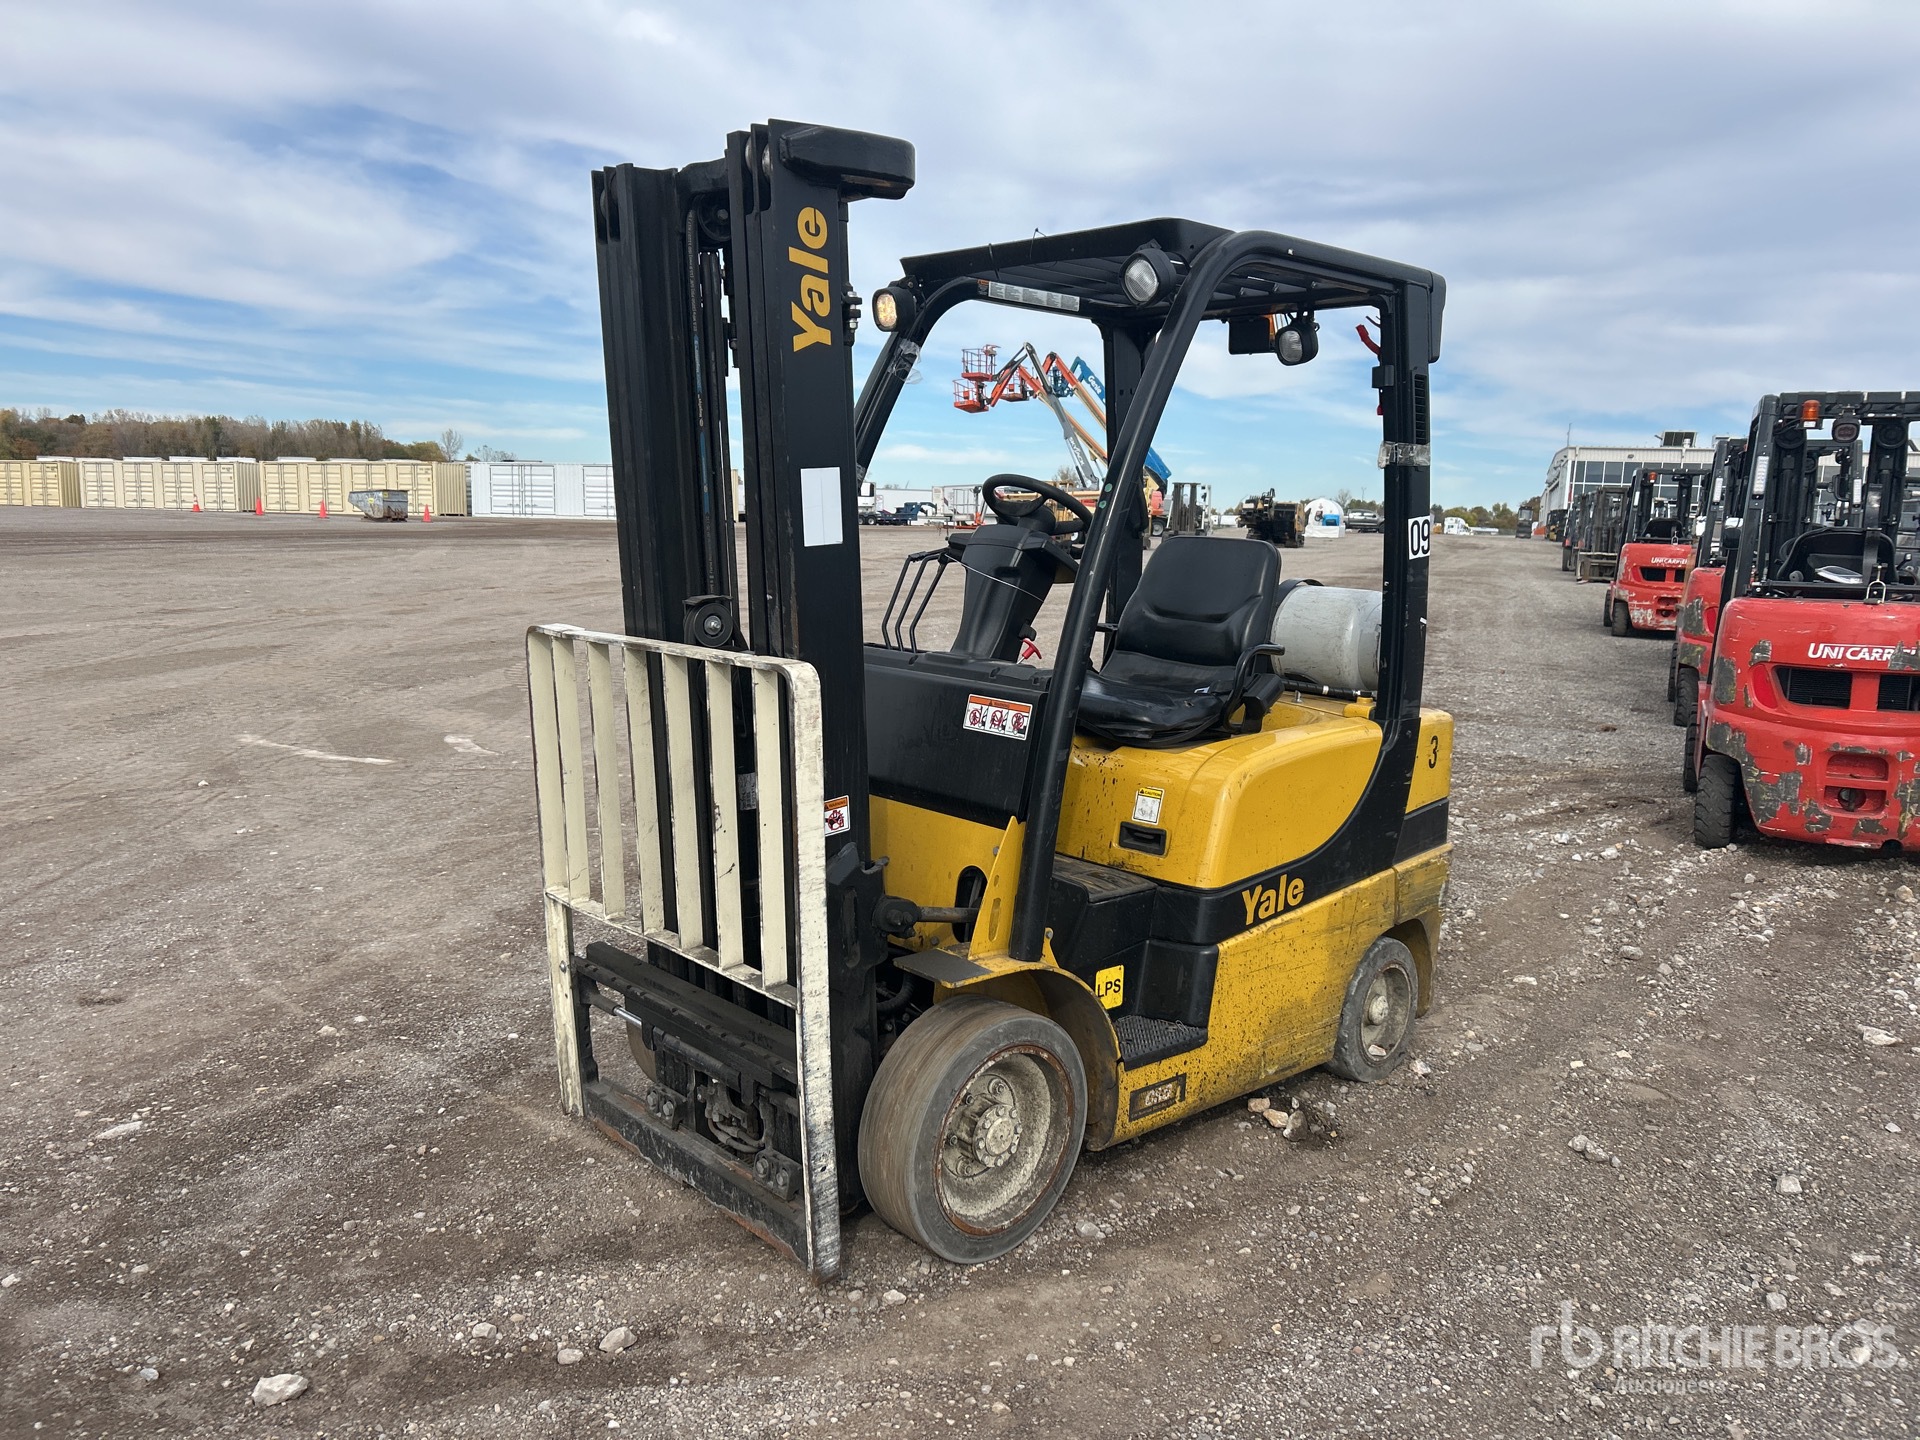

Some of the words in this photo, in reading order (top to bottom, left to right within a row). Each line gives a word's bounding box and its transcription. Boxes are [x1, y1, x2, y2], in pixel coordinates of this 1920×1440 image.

[789, 206, 831, 352] Yale
[1088, 375, 1102, 395] Genie
[1410, 519, 1430, 556] 09
[1428, 735, 1439, 769] 3
[1241, 873, 1305, 926] Yale
[1097, 978, 1121, 998] LPS
